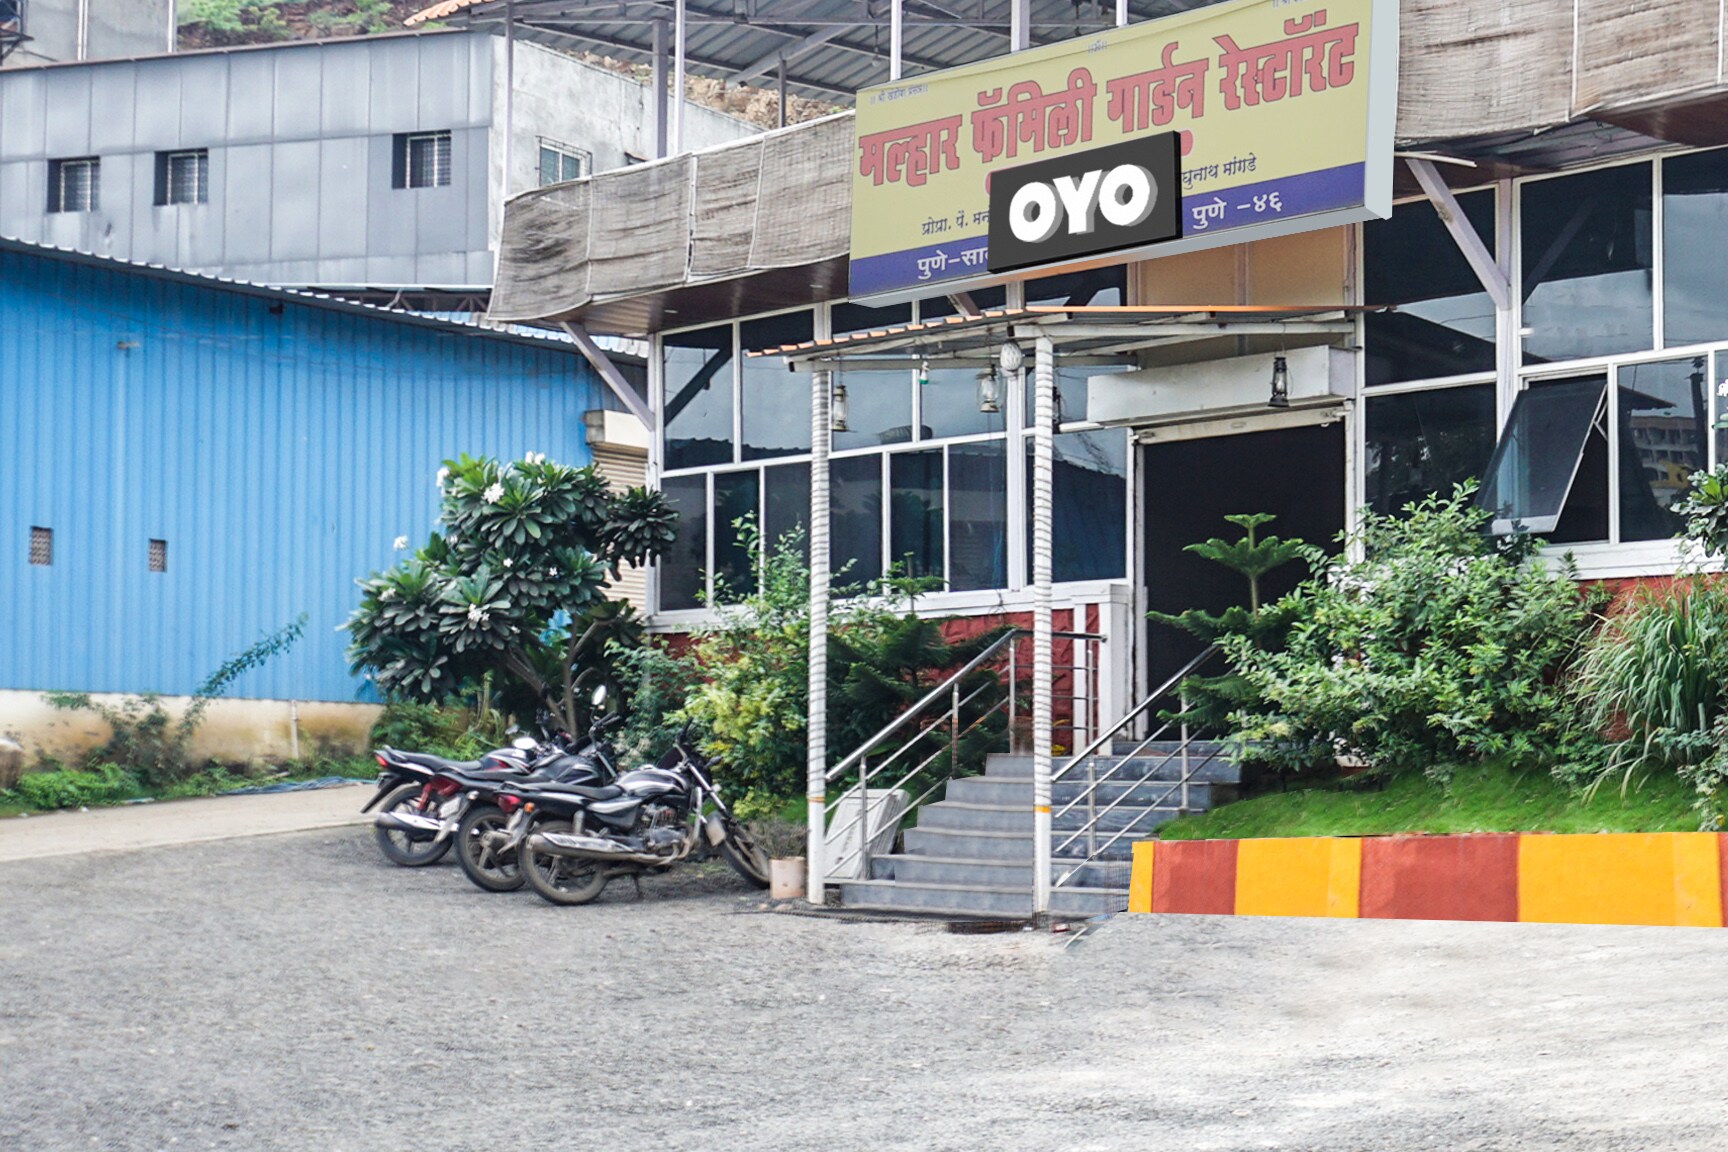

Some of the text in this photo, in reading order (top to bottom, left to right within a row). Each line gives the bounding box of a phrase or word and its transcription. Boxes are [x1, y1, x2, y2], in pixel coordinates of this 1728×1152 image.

[859, 9, 1359, 187] मल्हार फॅमिली गार्डन रेस्टॉरंट
[1181, 152, 1256, 189] घुनाथ मांगडे
[1009, 164, 1156, 243] OYO
[1192, 197, 1227, 229] पुणे
